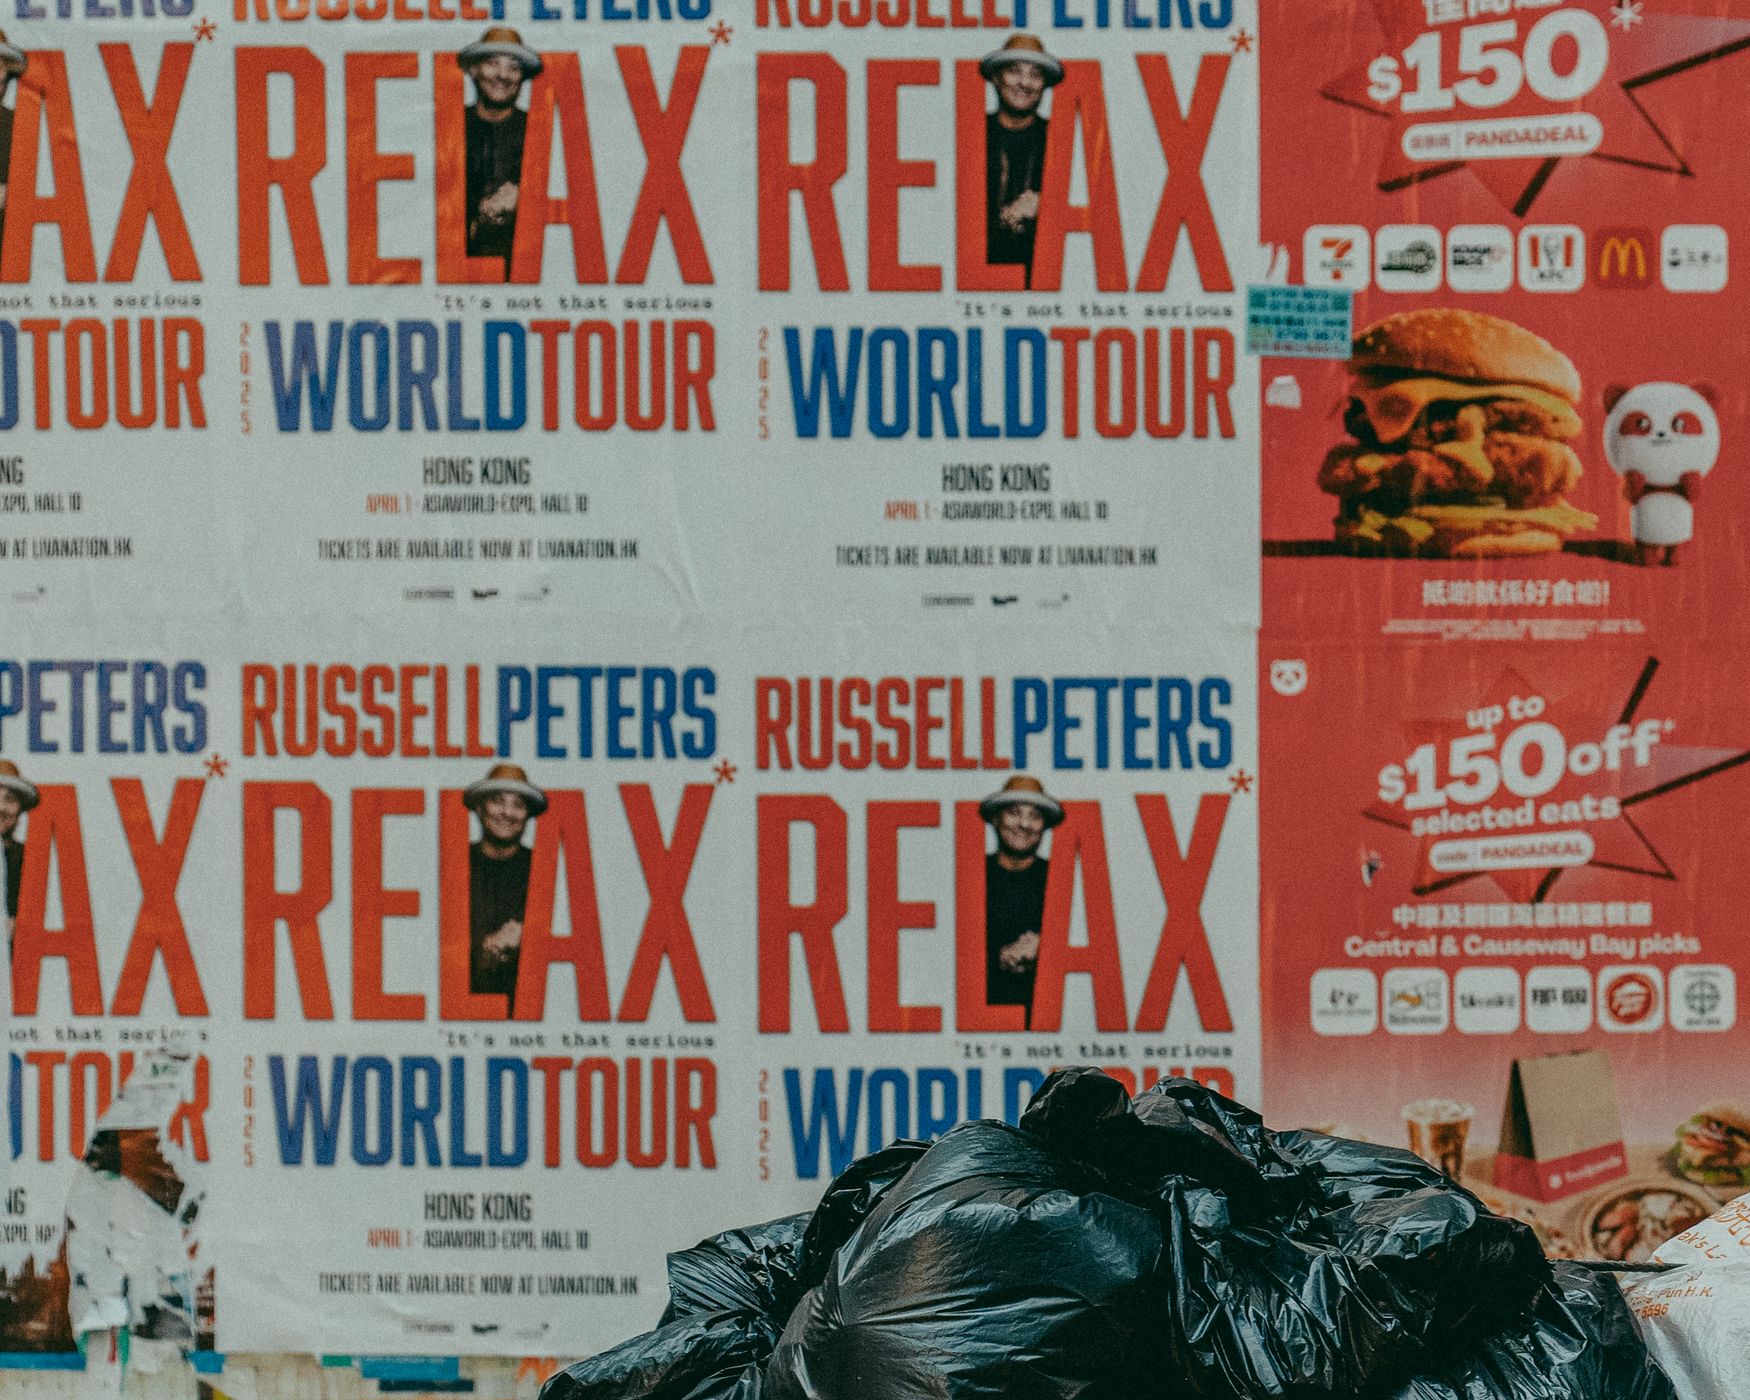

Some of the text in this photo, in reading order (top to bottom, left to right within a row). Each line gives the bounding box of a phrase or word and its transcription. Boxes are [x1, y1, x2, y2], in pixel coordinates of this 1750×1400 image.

[1367, 9, 1610, 113] $150
[1464, 126, 1589, 147] PANDADEAL
[49, 291, 98, 308] that
[113, 293, 202, 308] serious
[506, 295, 542, 309] not
[559, 294, 607, 309] that
[623, 294, 712, 309] serious
[1026, 303, 1063, 317] not
[1079, 302, 1127, 317] that
[1144, 302, 1233, 317] serious
[21, 318, 206, 429] TOUR
[423, 456, 531, 484] HONG KONG
[943, 464, 1051, 491] HONG KONG
[366, 493, 400, 513] APRIL
[541, 494, 569, 513] HALL
[885, 500, 919, 520] APRIL
[318, 538, 370, 560] TICKETS
[375, 538, 400, 560] ARE
[406, 538, 473, 560] AVAILABLE
[480, 538, 511, 559] NOW
[518, 538, 532, 559] AT
[836, 546, 888, 566] TICKETS
[894, 546, 919, 566] ARE
[925, 546, 993, 566] AVAILABLE
[1000, 546, 1031, 566] NOW
[1038, 546, 1051, 566] AT
[1467, 696, 1546, 731] up to
[1412, 795, 1622, 836] selected eats
[1344, 932, 1700, 958] Central & Causeway Bay picks
[56, 1027, 102, 1041] that
[509, 1034, 545, 1048] not
[561, 1033, 609, 1048] that
[626, 1033, 714, 1048] serious
[1027, 1045, 1062, 1059] not
[1080, 1043, 1127, 1059] that
[1144, 1044, 1232, 1058] serious
[425, 1193, 532, 1221] HONG KONG
[367, 1229, 400, 1248] APRIL
[541, 1230, 570, 1249] HALL
[319, 1272, 370, 1294] TICKETS
[376, 1272, 400, 1294] ARE
[407, 1272, 474, 1295] AVAILABLE
[481, 1273, 512, 1295] NOW
[519, 1274, 533, 1295] AT
